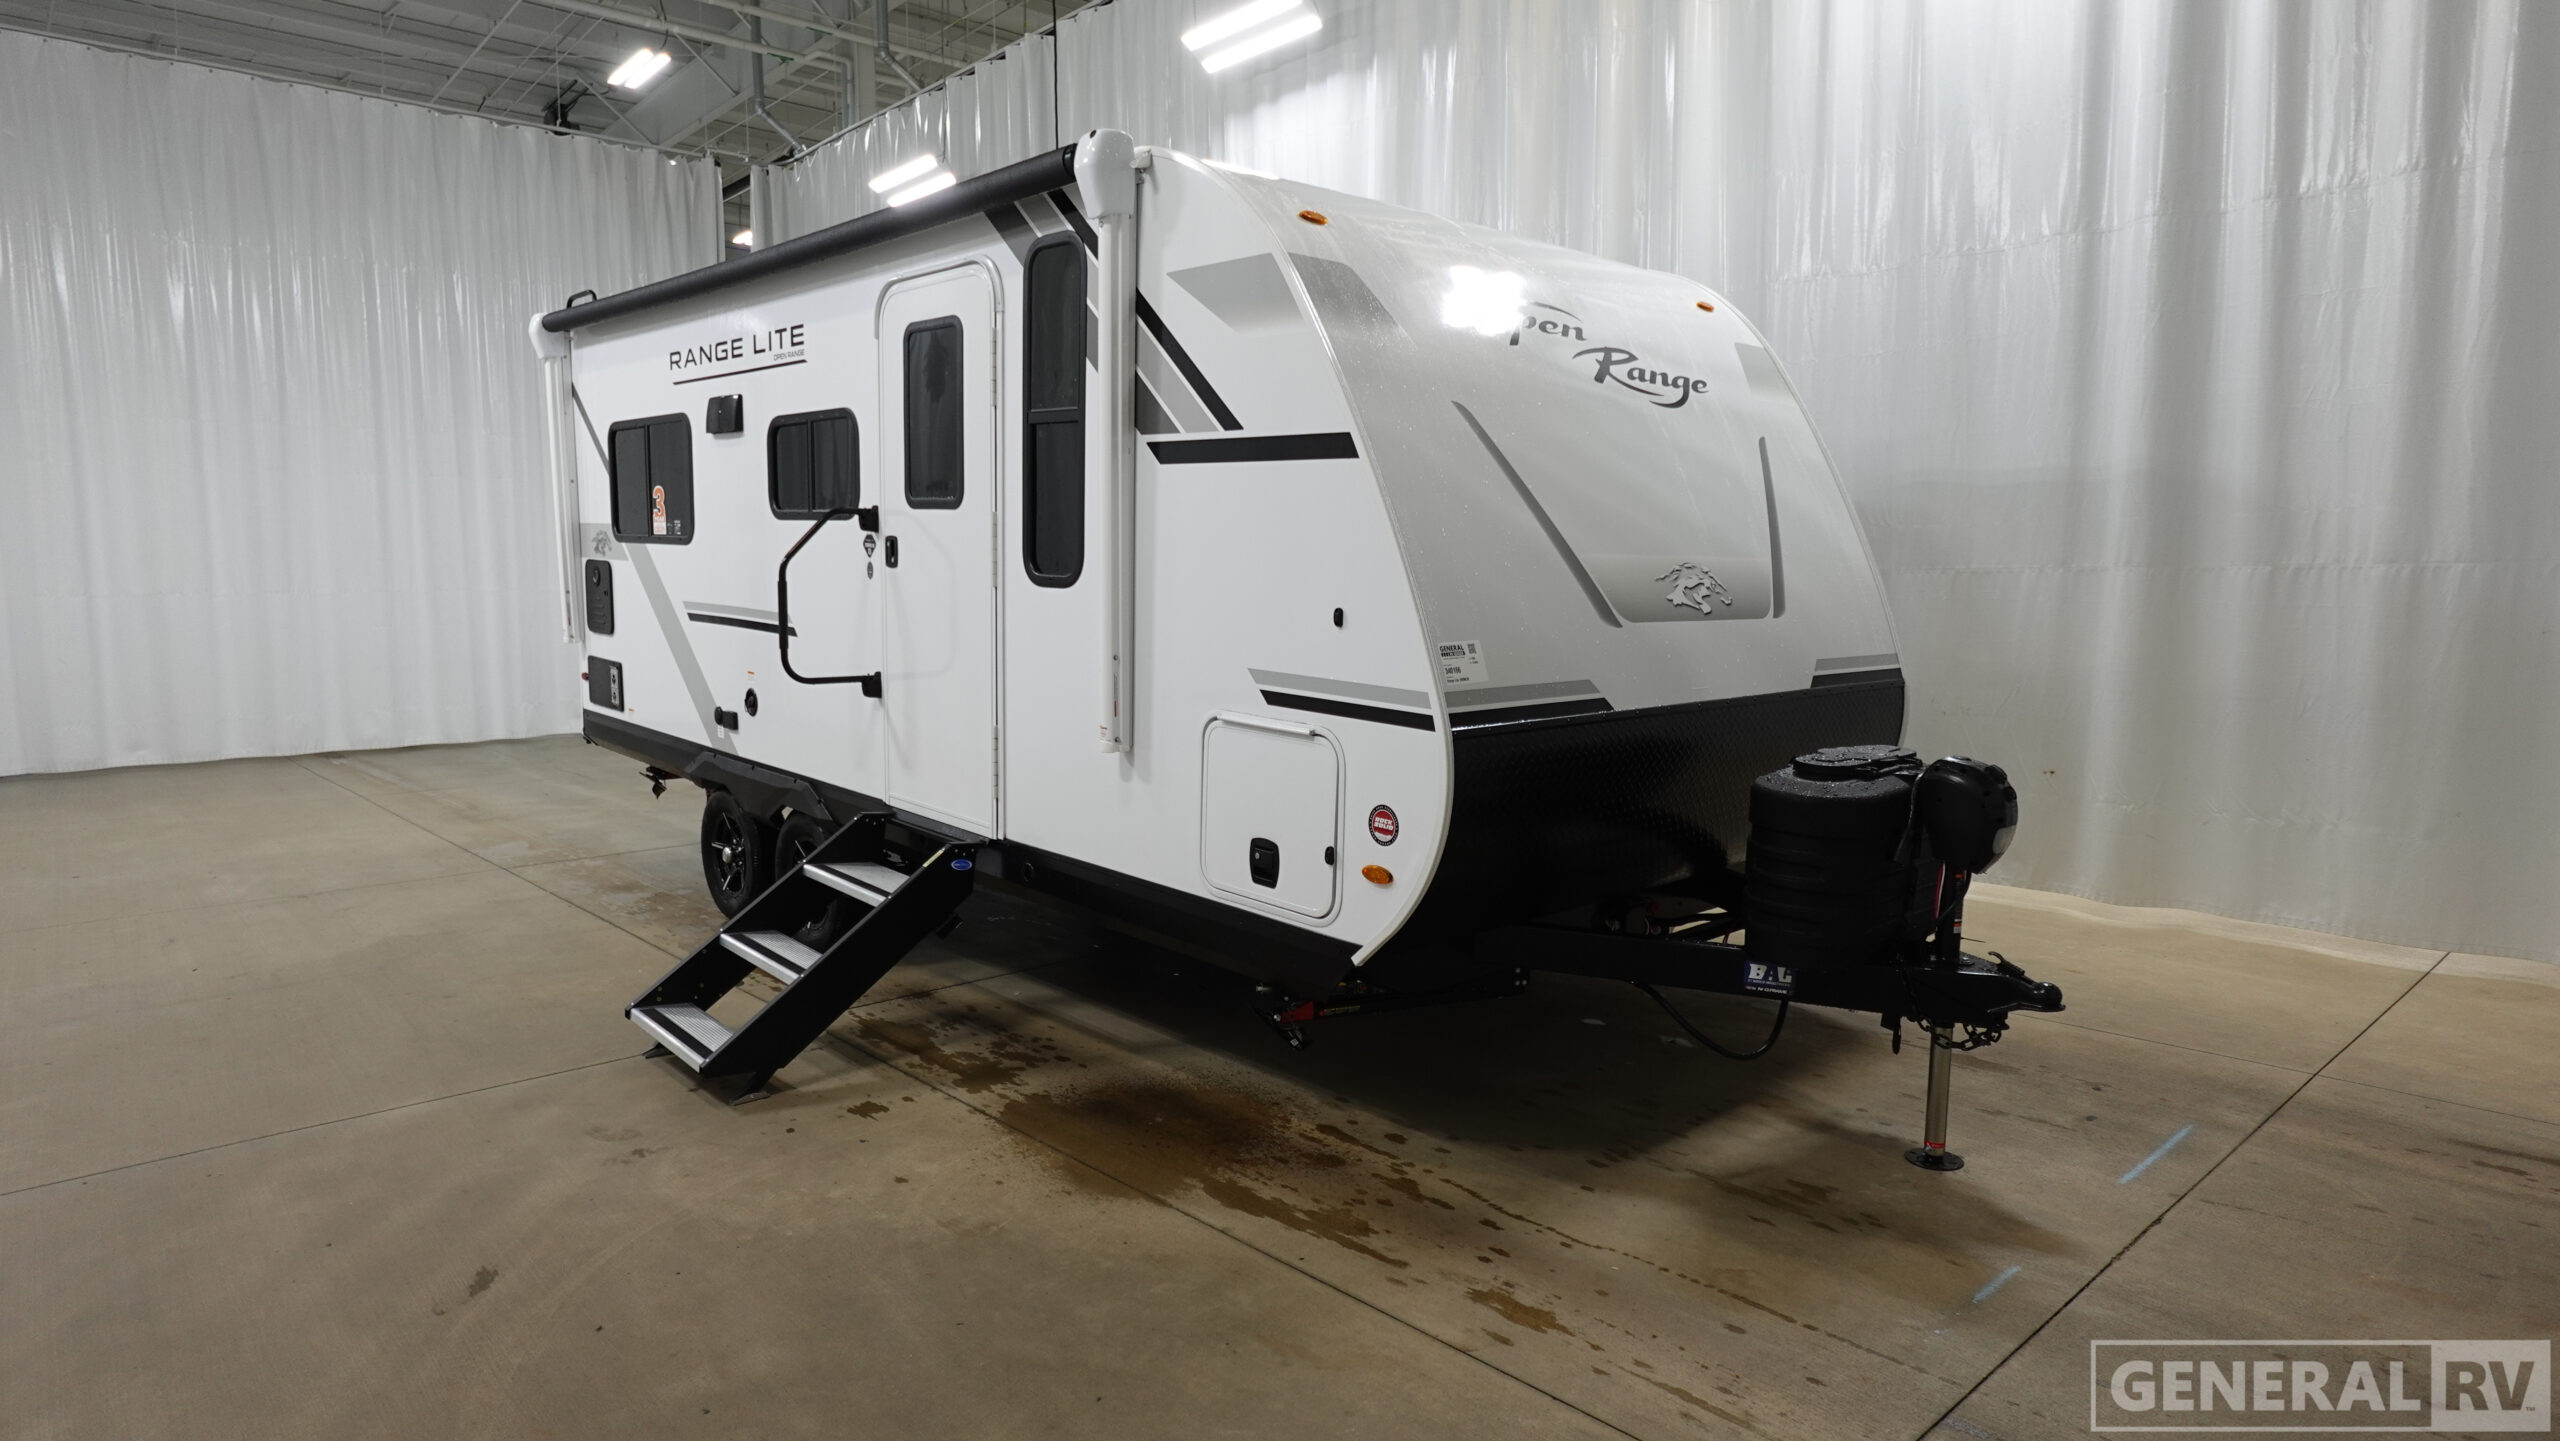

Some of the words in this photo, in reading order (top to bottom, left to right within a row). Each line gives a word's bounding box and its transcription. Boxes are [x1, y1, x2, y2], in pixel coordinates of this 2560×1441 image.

[1508, 301, 1588, 346] pen
[669, 337, 743, 370] RANGE
[753, 324, 805, 354] LITE
[1572, 346, 1710, 408] Range
[652, 486, 666, 517] 3
[1439, 644, 1465, 652] GENERAL
[1374, 821, 1394, 831] SOLID
[1375, 816, 1393, 825] ROCK
